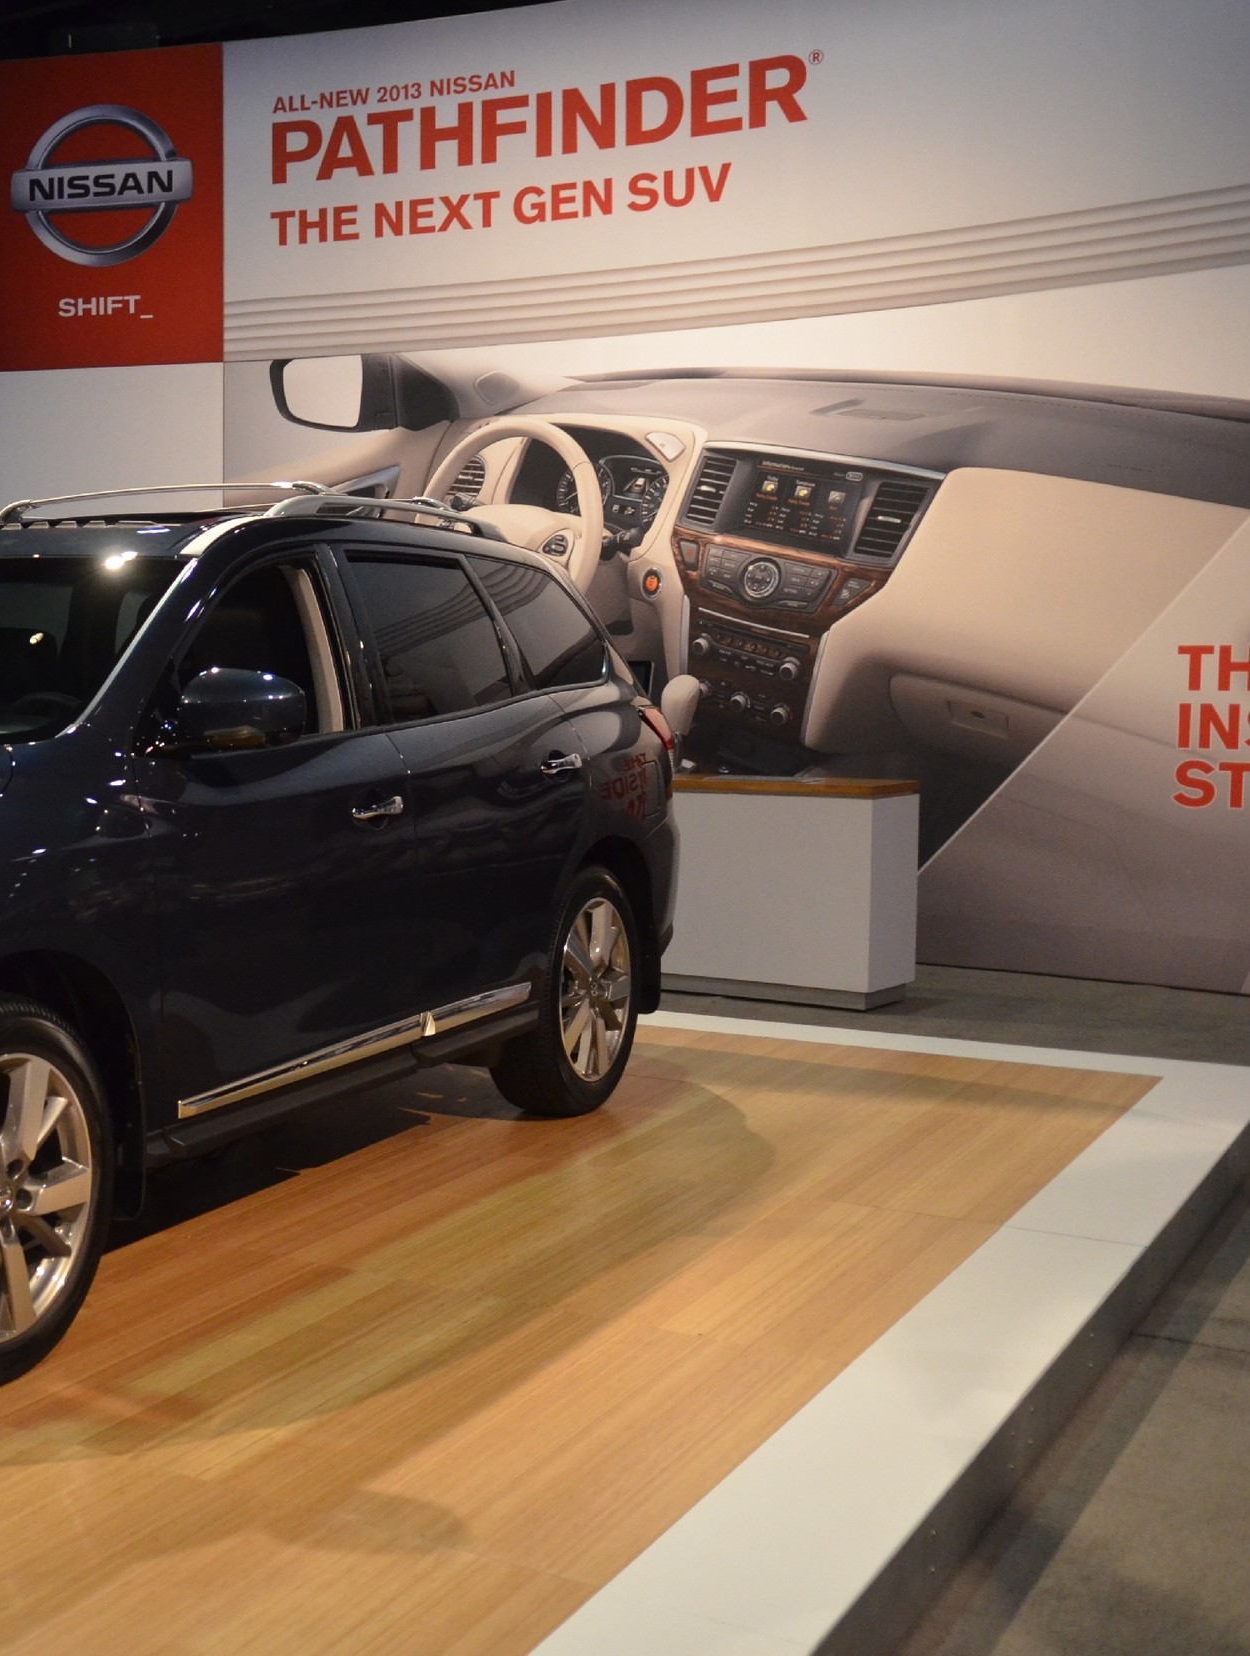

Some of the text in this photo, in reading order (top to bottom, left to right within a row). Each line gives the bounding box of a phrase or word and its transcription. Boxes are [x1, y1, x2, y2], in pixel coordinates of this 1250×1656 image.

[272, 69, 516, 114] ALL-NEW 2013 NISSAN
[28, 168, 174, 203] NISSAN
[270, 162, 733, 247] THE NEXT GEN SUV
[1177, 703, 1250, 750] IN
